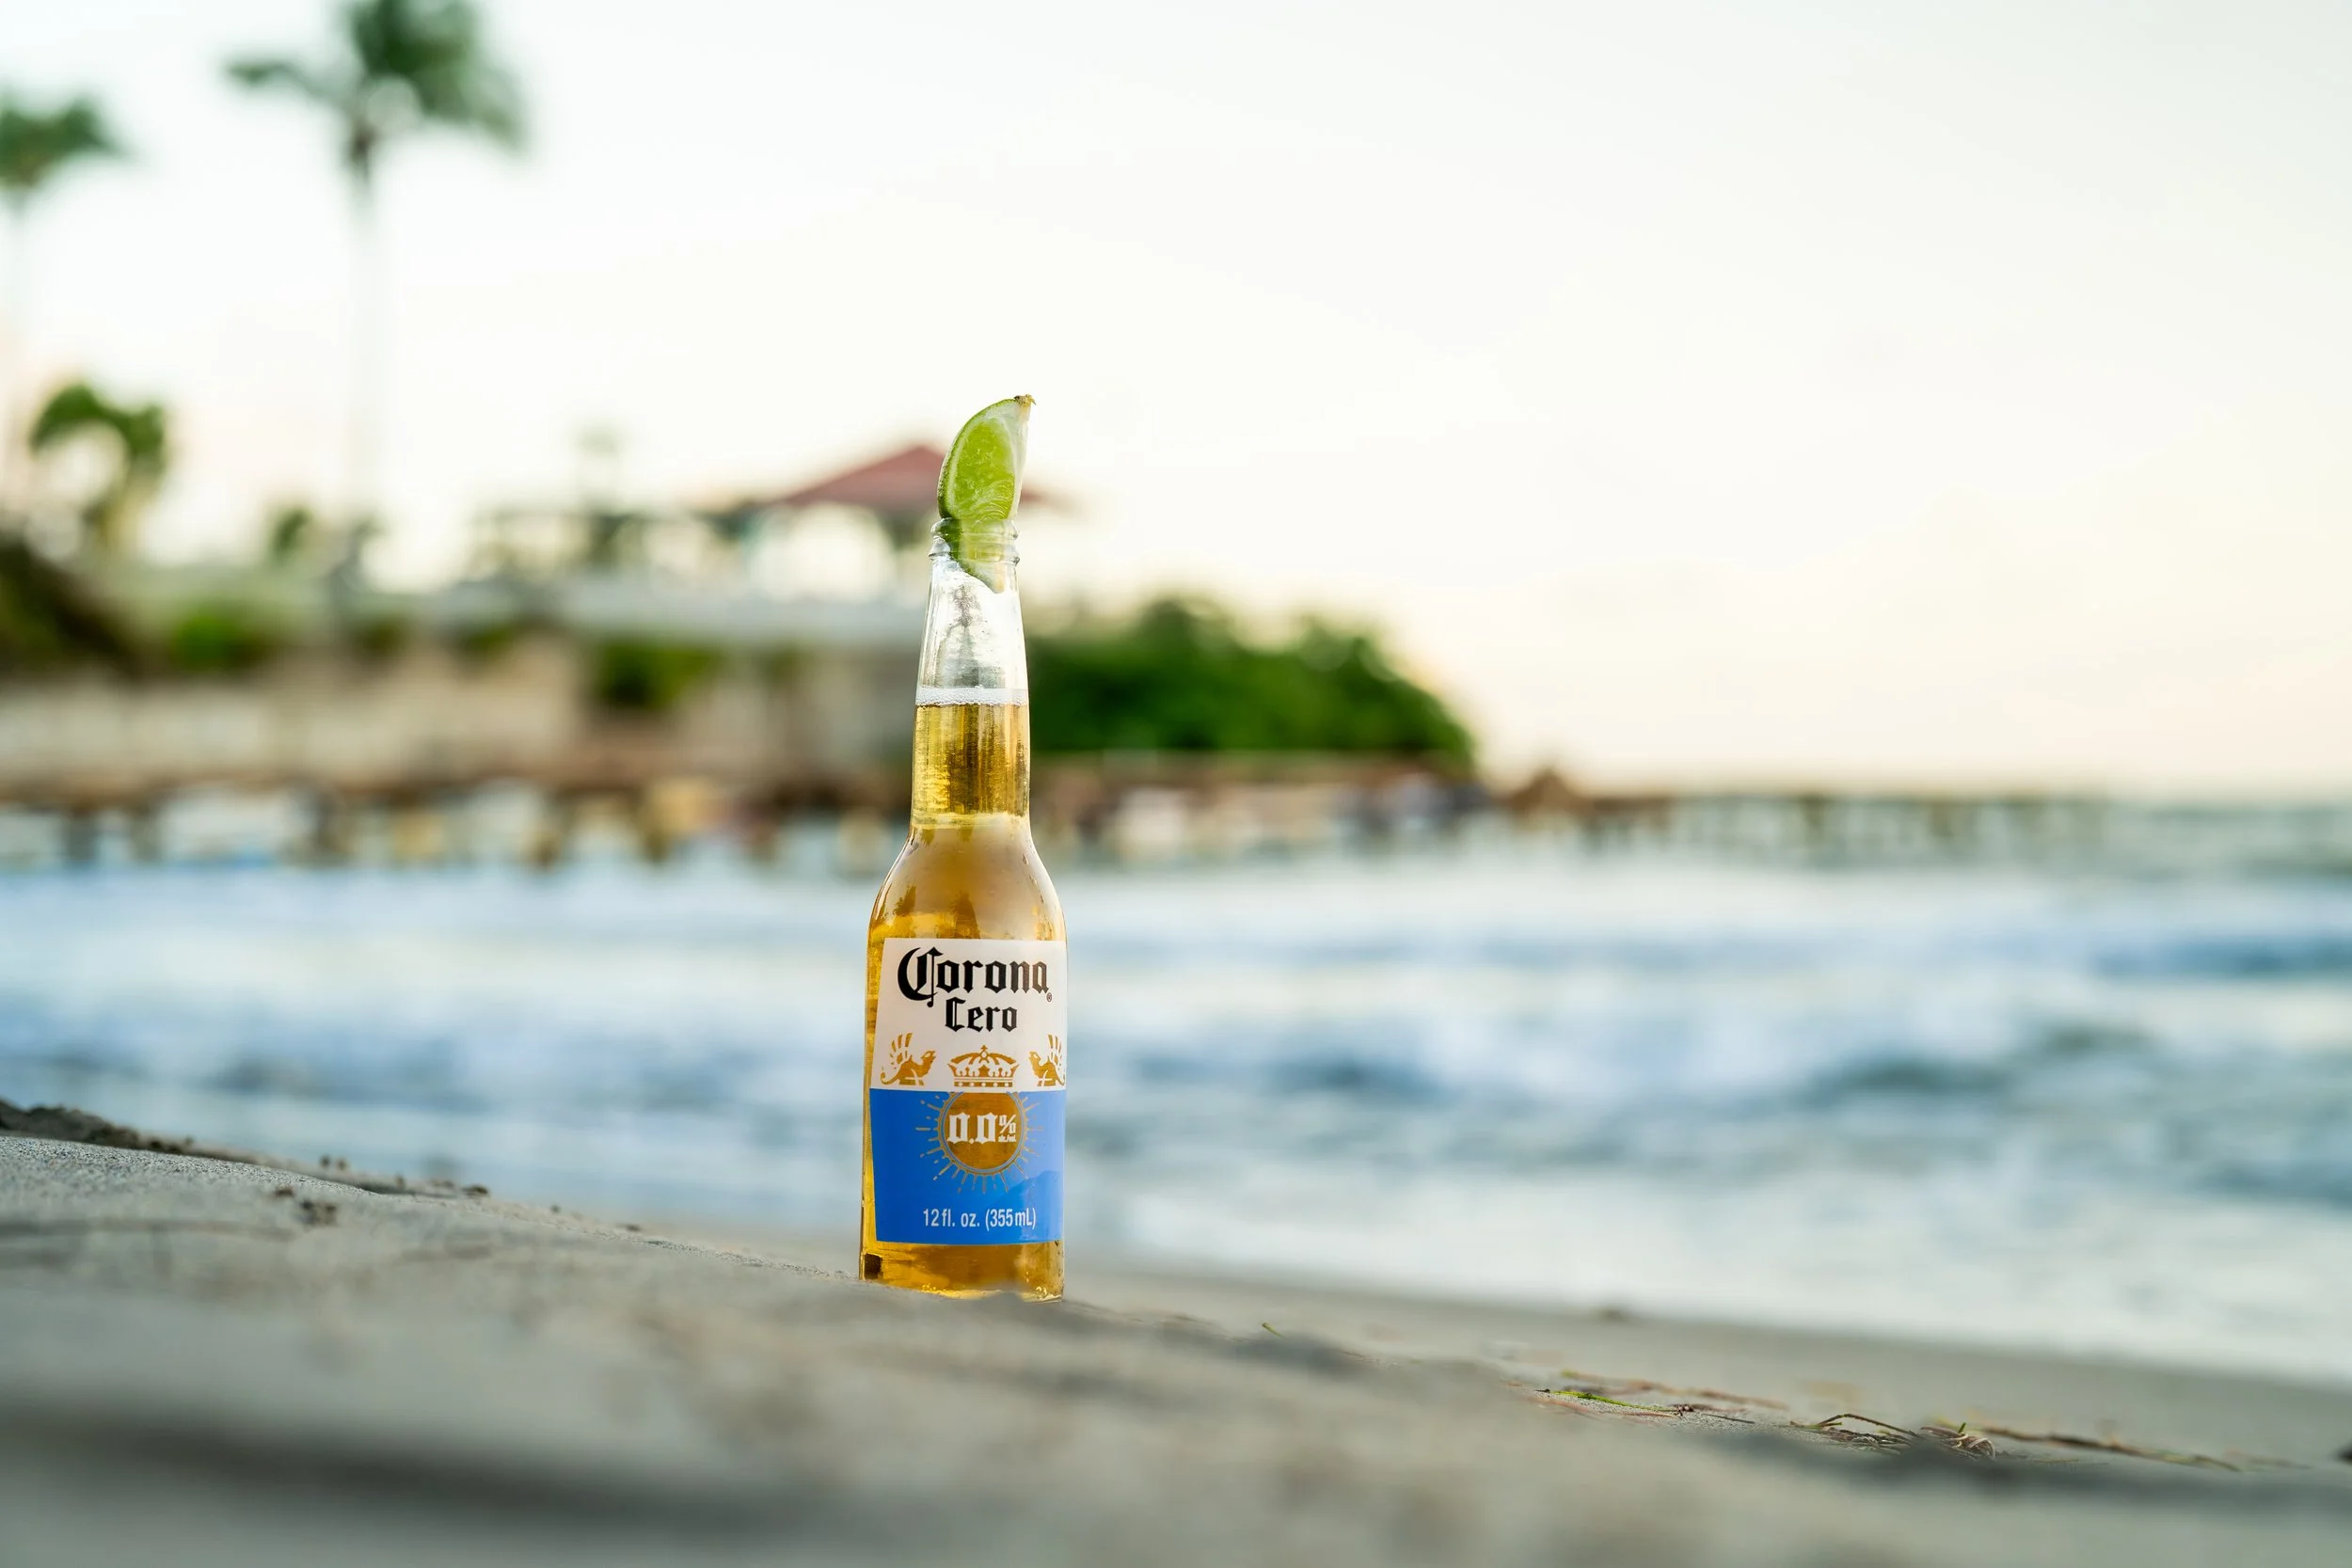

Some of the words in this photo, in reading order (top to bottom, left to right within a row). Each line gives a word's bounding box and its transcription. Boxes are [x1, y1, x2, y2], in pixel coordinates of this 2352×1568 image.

[898, 946, 1049, 1008] Corona
[945, 996, 1017, 1033] Cero
[946, 1112, 1016, 1144] 0.0%
[961, 1212, 980, 1227] oz.
